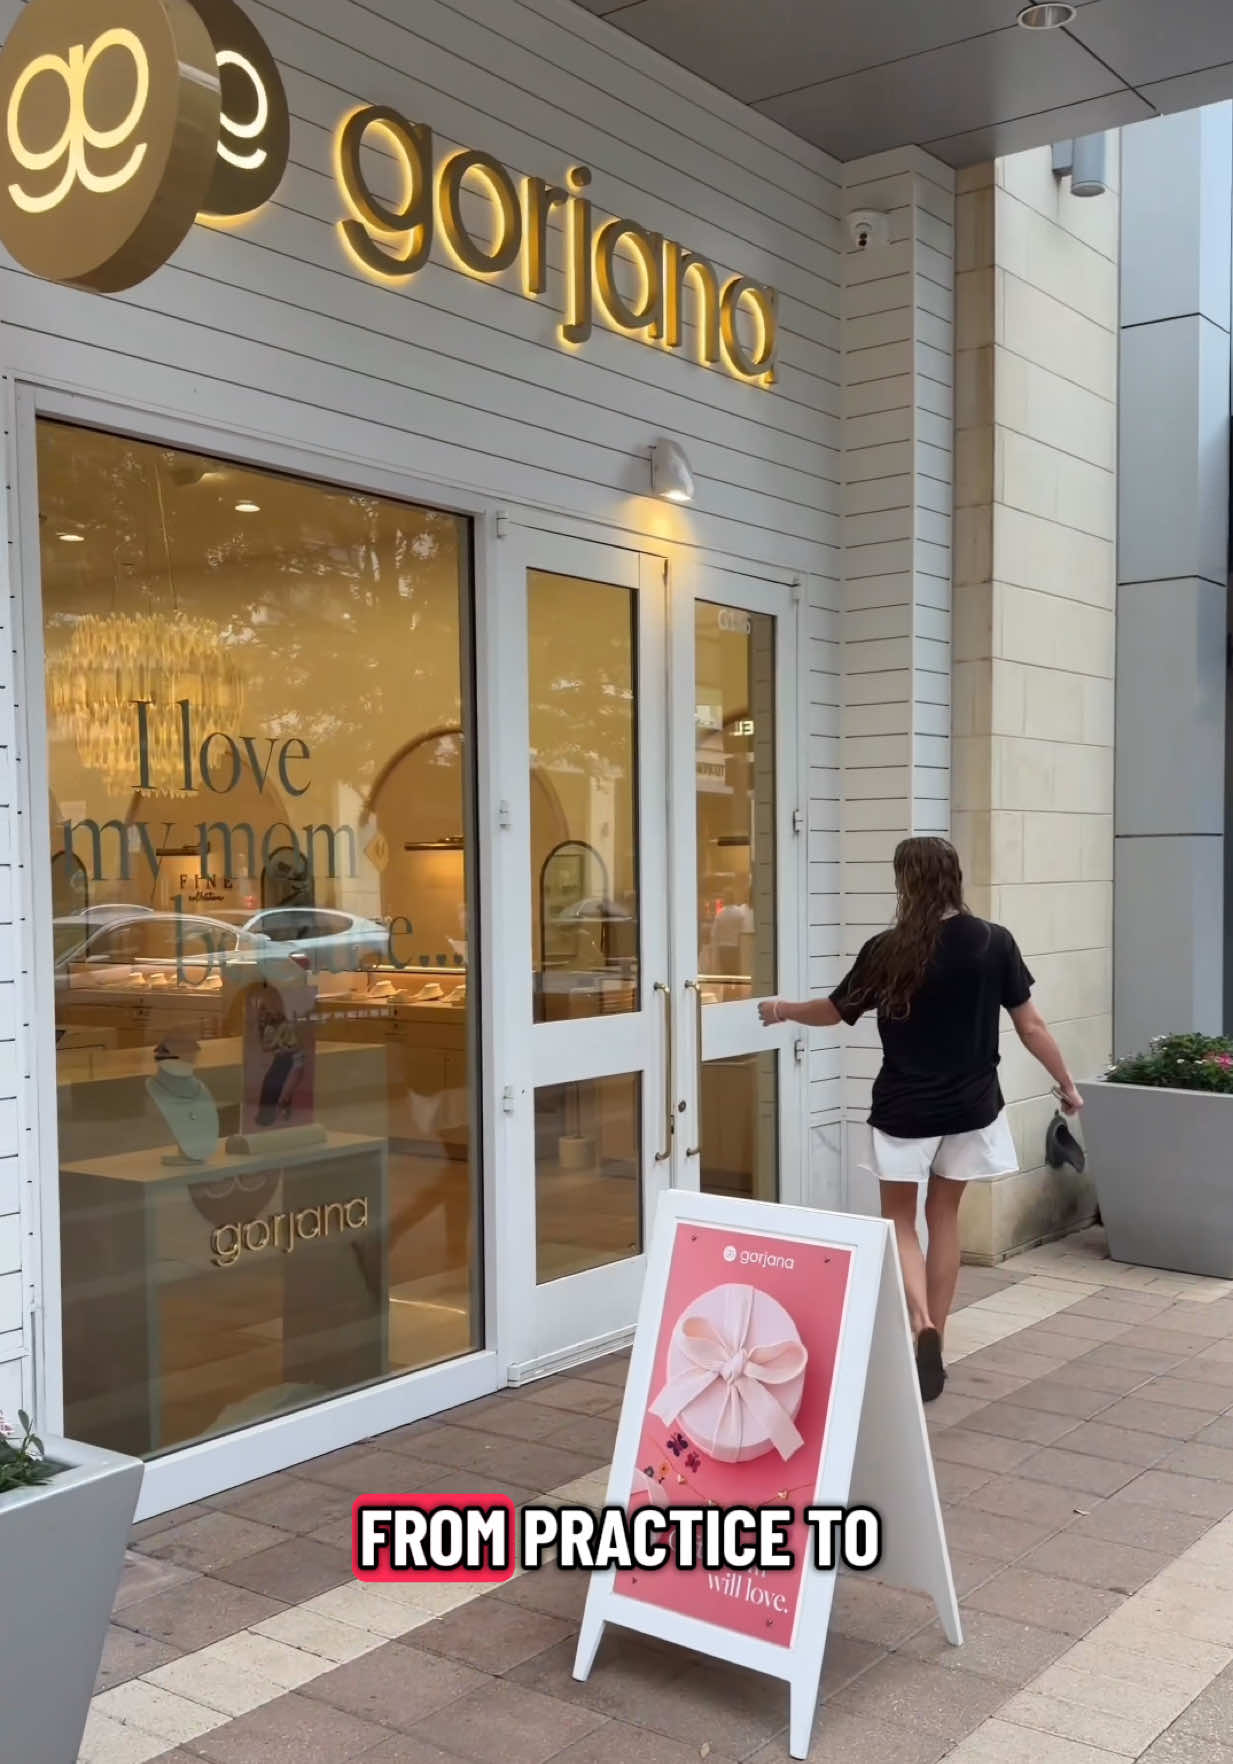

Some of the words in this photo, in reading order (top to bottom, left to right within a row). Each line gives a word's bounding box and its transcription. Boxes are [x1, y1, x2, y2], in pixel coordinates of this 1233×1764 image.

[337, 104, 776, 384] gorjana
[128, 699, 156, 789] I
[176, 698, 312, 797] love
[58, 818, 176, 900] my
[197, 821, 362, 881] mom
[210, 1196, 368, 1267] gorjana
[740, 1249, 795, 1269] gorjana
[708, 1572, 742, 1599] will
[746, 1576, 789, 1614] love.
